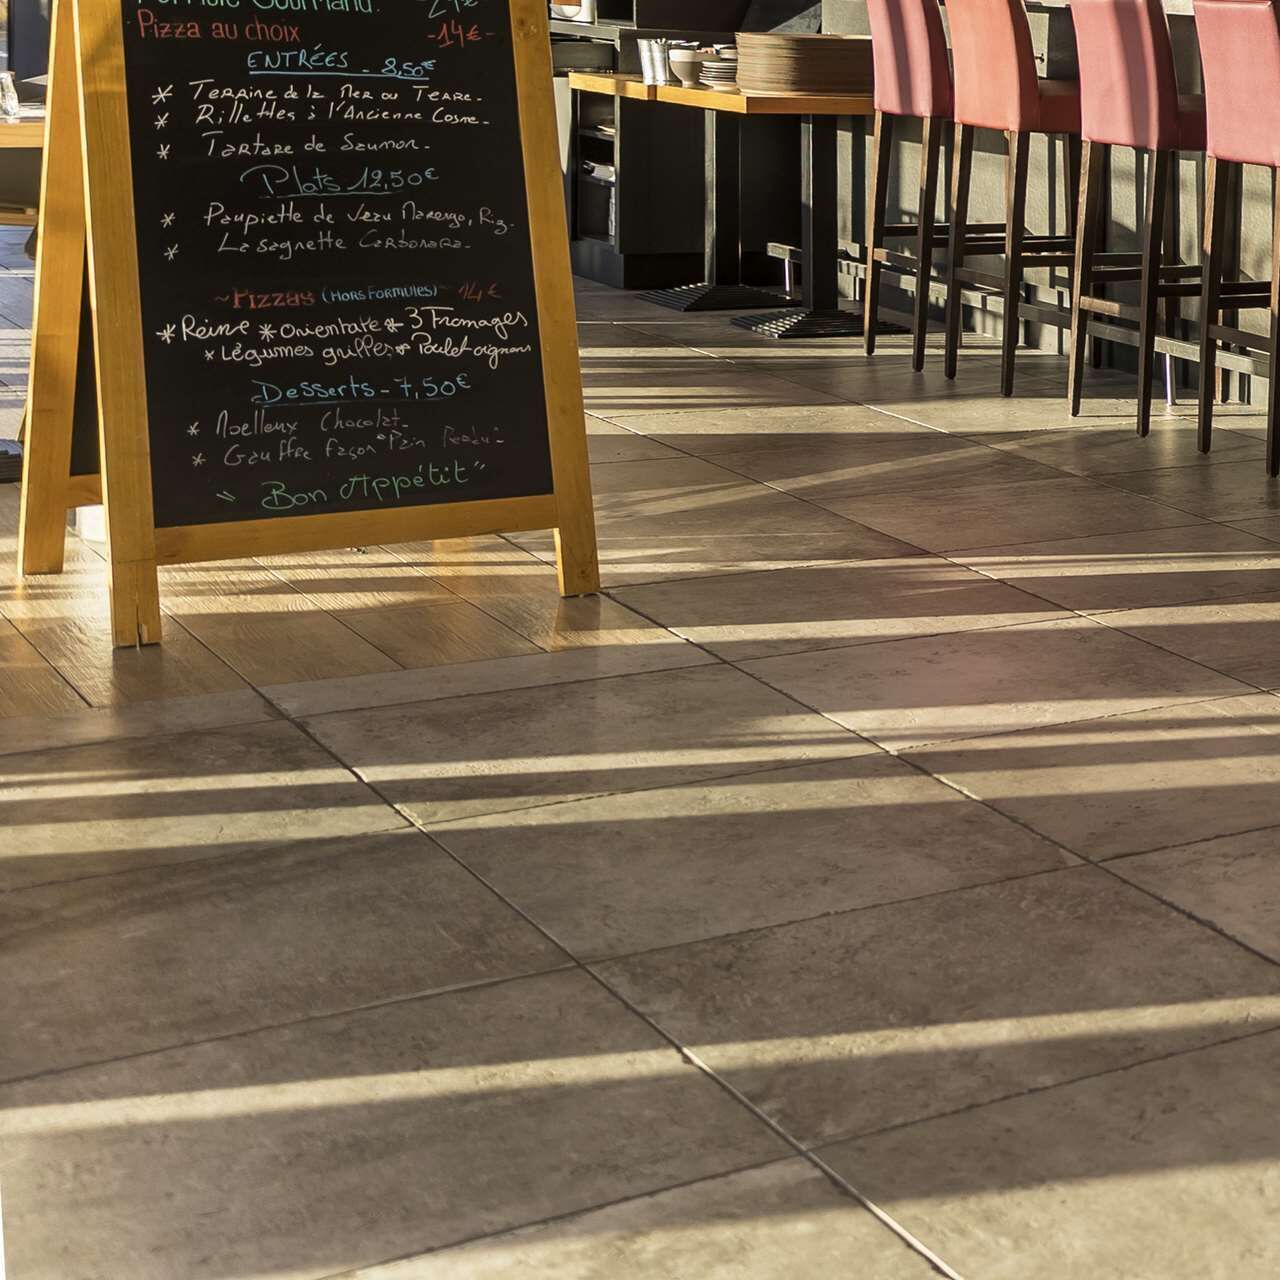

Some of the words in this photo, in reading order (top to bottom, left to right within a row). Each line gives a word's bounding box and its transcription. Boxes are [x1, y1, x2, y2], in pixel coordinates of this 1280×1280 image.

[137, 8, 201, 39] Pizza
[211, 22, 238, 40] au
[245, 16, 301, 42] choix
[247, 43, 348, 70] ENTRÉES
[283, 84, 299, 100] de
[306, 83, 325, 100] la
[381, 91, 399, 101] ou
[195, 101, 295, 125] Rillettes
[308, 104, 317, 121] à
[328, 100, 423, 120] l'Ancienne
[201, 130, 294, 158] Tartare
[304, 134, 327, 153] de
[239, 164, 341, 196] Plats
[203, 202, 303, 236] Paupiette
[313, 203, 335, 224] de
[181, 314, 250, 342] Reine
[404, 305, 424, 329] 3
[420, 306, 529, 340] Fromages
[221, 342, 315, 367] Légumes
[411, 331, 473, 358] Poulet
[250, 376, 376, 404] Desserts
[216, 409, 299, 439] Moelleux
[260, 481, 328, 510] Bon
